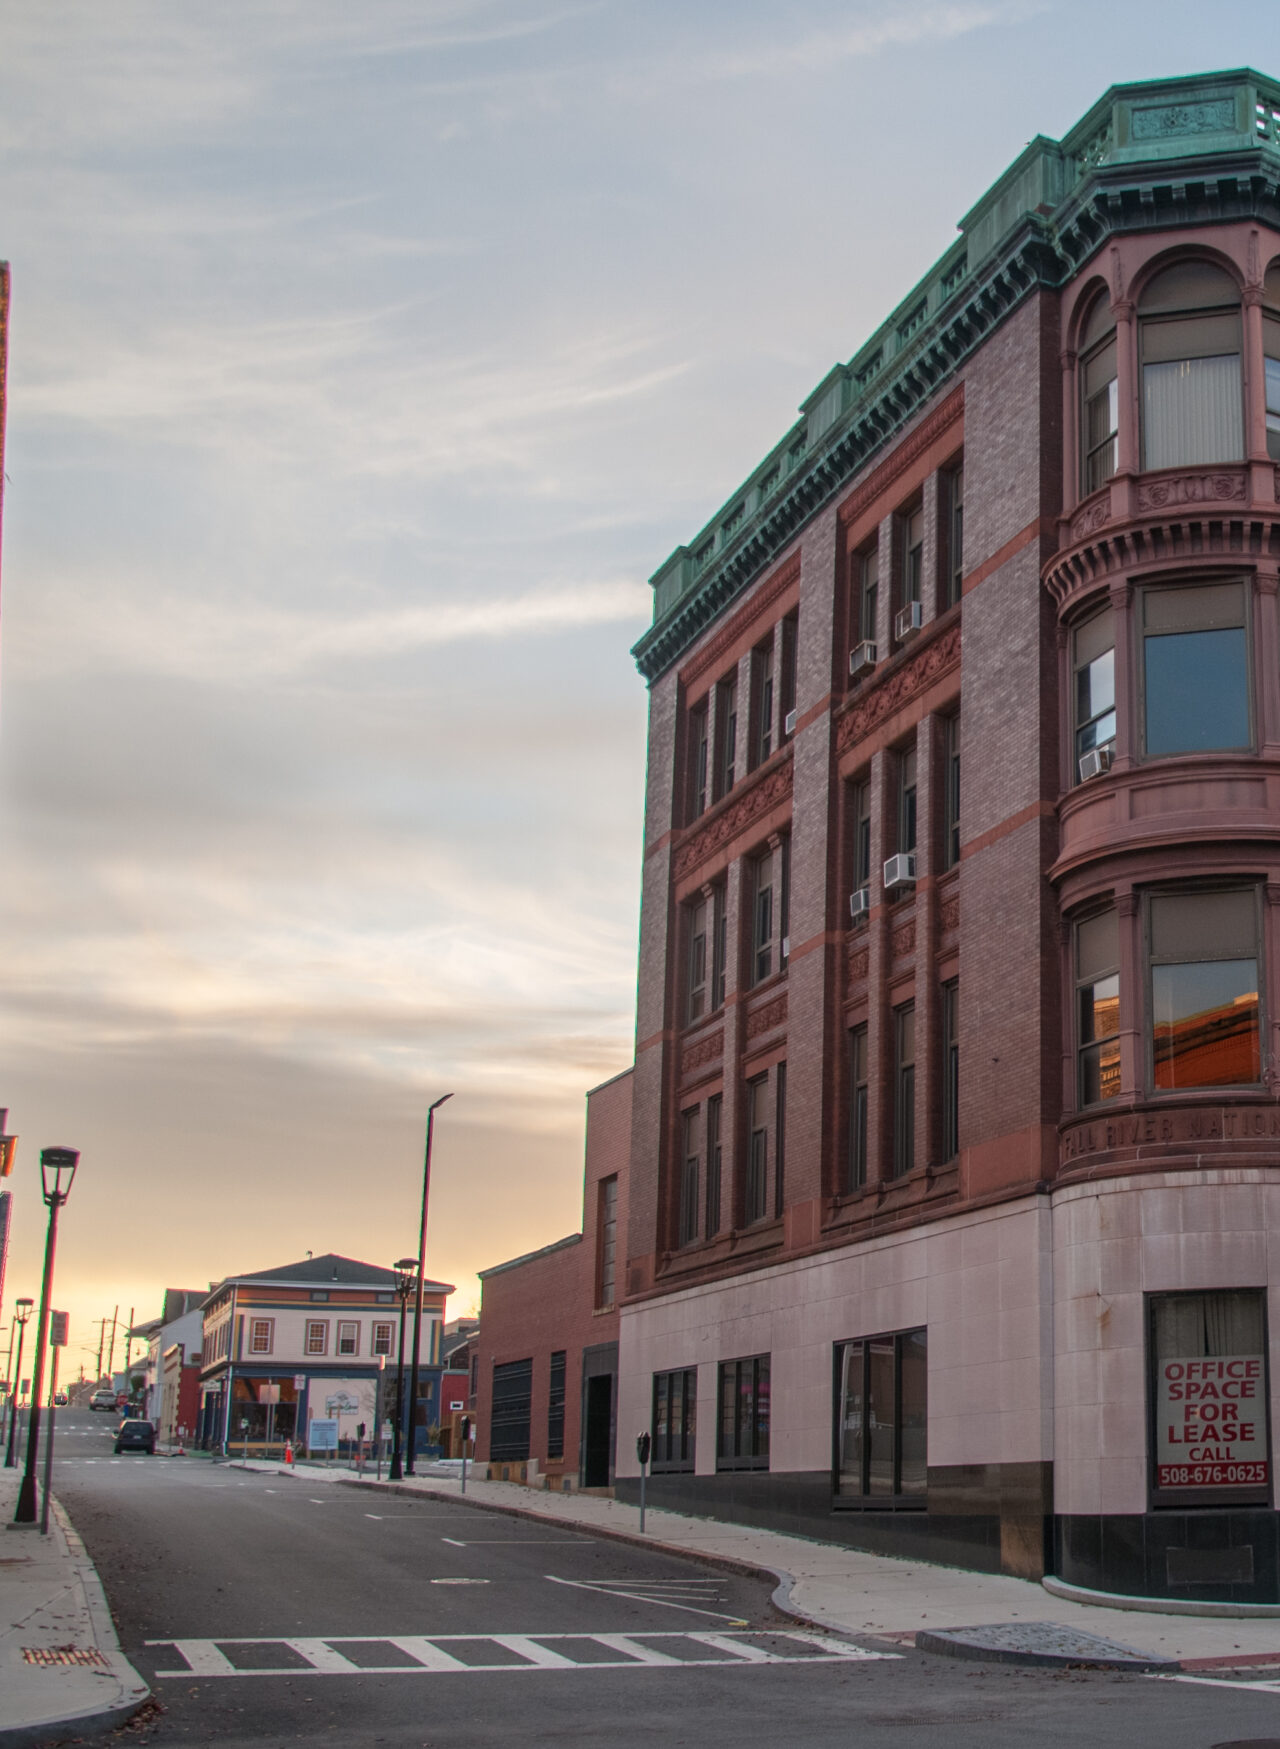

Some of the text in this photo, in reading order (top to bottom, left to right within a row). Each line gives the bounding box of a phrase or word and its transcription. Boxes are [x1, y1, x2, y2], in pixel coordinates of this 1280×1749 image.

[1065, 1125, 1097, 1155] FALL
[1106, 1118, 1173, 1145] RIVER
[1165, 1361, 1260, 1380] OFFICE
[1168, 1381, 1255, 1401] SPACE
[1185, 1403, 1238, 1422] FOR
[1168, 1423, 1255, 1443] LEASE
[1189, 1447, 1235, 1461] CALL
[1162, 1465, 1265, 1484] 508-676-0625
